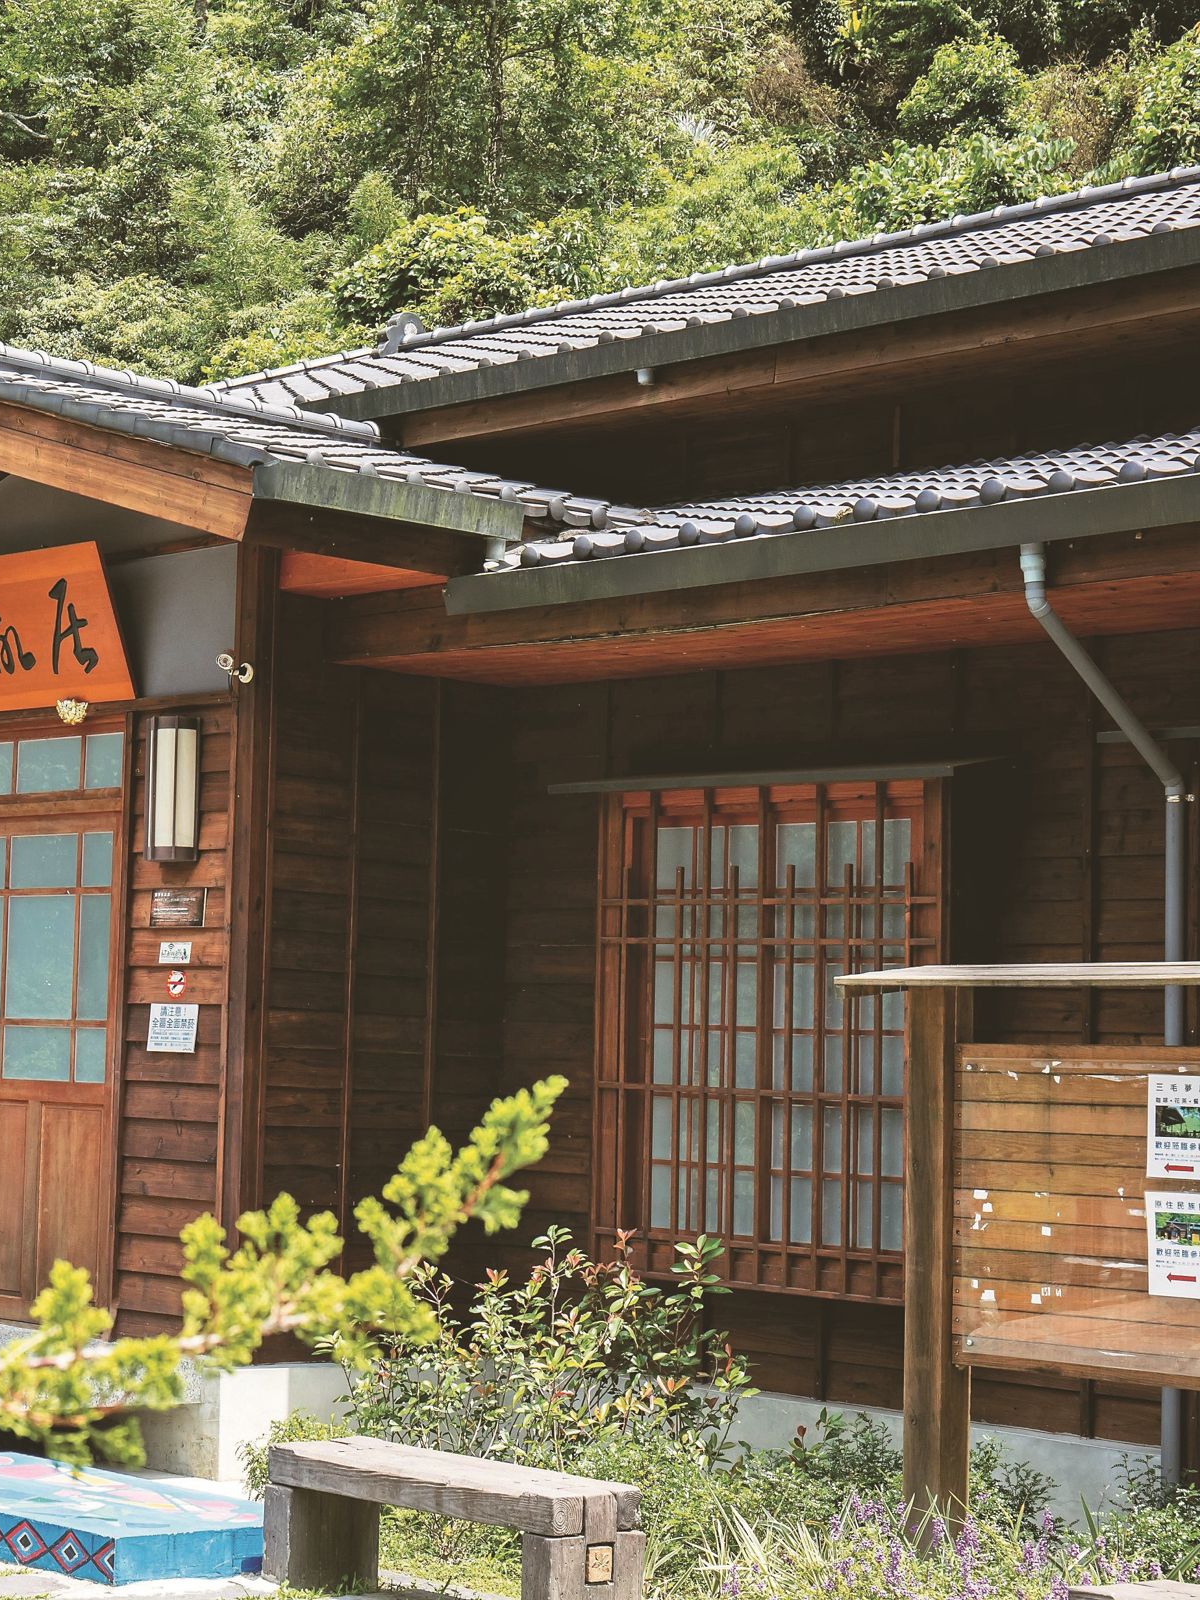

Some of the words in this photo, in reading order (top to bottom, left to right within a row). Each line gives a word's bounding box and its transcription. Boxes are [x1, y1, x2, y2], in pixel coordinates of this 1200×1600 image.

[1156, 1083, 1200, 1093] 三毛夢
[1155, 1141, 1200, 1151] 歡迎蒞臨參
[1154, 1200, 1200, 1210] 原住民族
[1156, 1247, 1200, 1258] 歡迎蒞臨參
